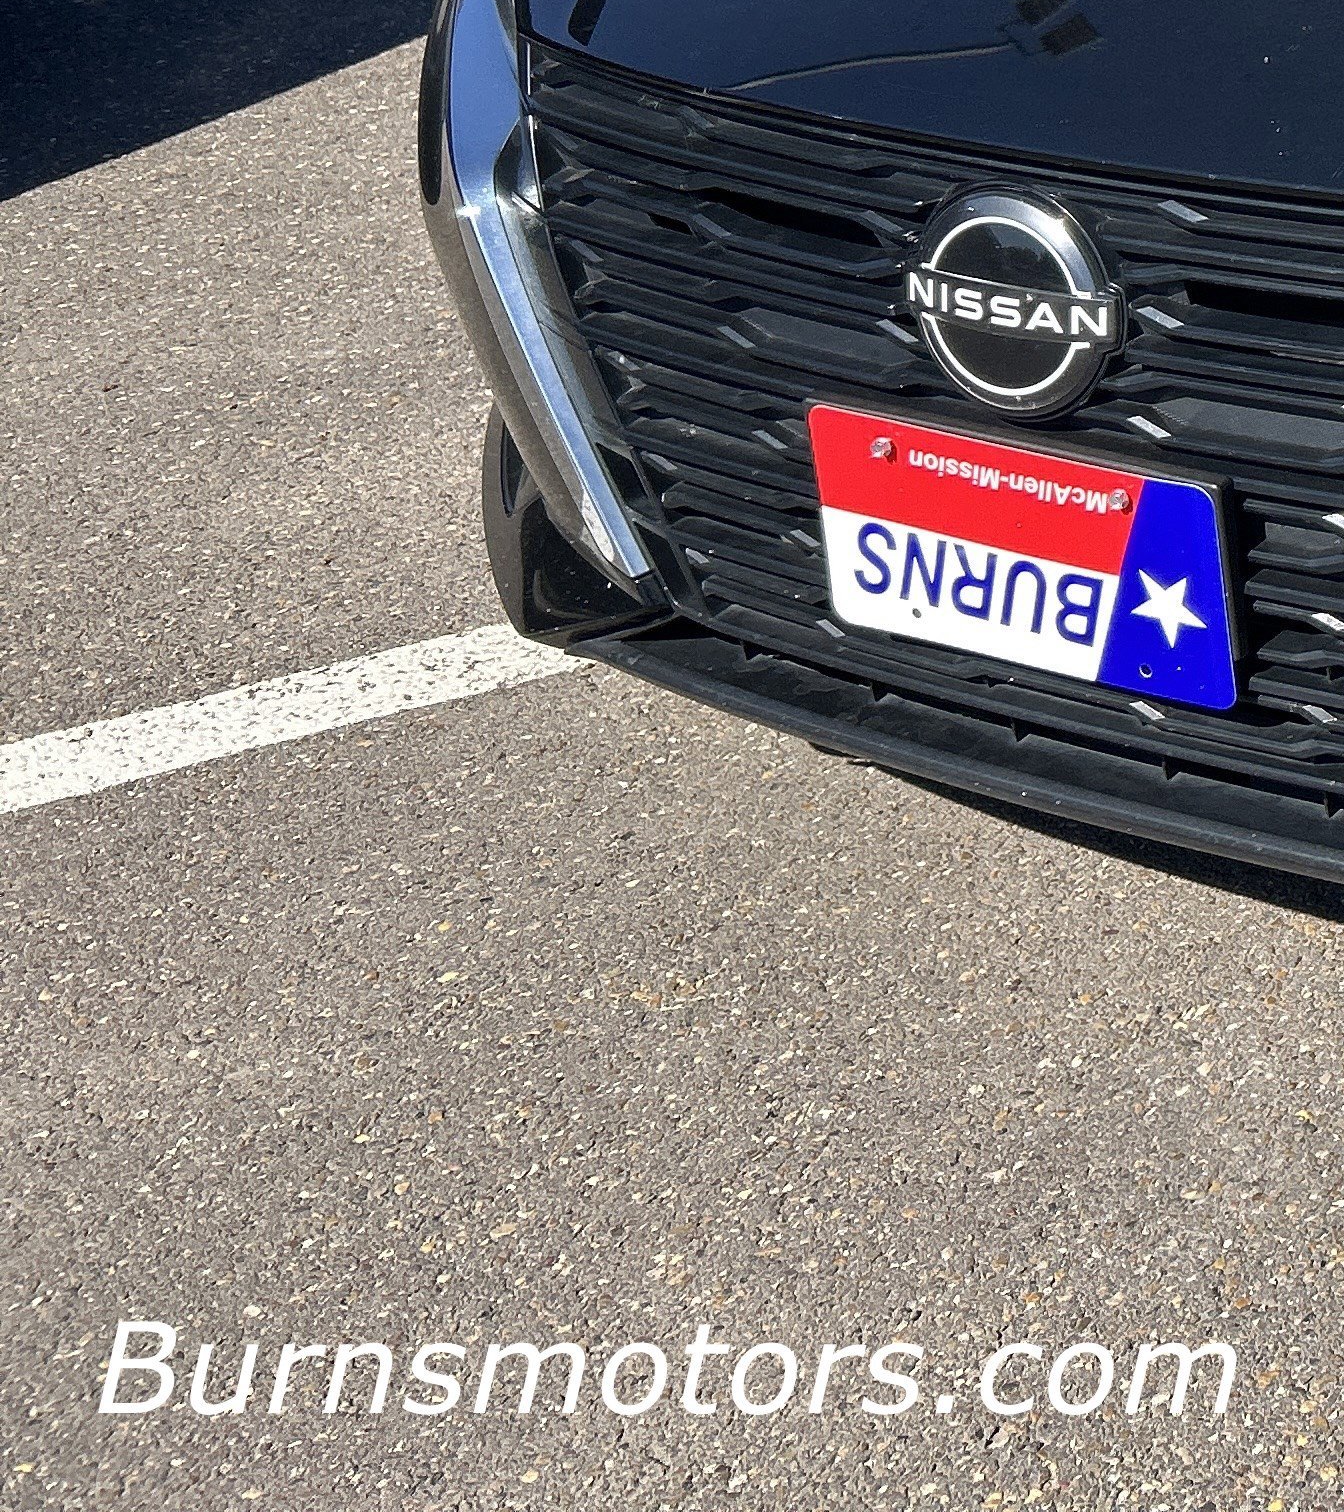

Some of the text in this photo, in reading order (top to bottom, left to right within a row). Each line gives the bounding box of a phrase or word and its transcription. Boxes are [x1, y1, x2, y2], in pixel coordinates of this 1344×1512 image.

[907, 271, 1108, 337] NISSAN
[908, 448, 1109, 514] McAllen-Mission
[854, 522, 1103, 646] BURNS
